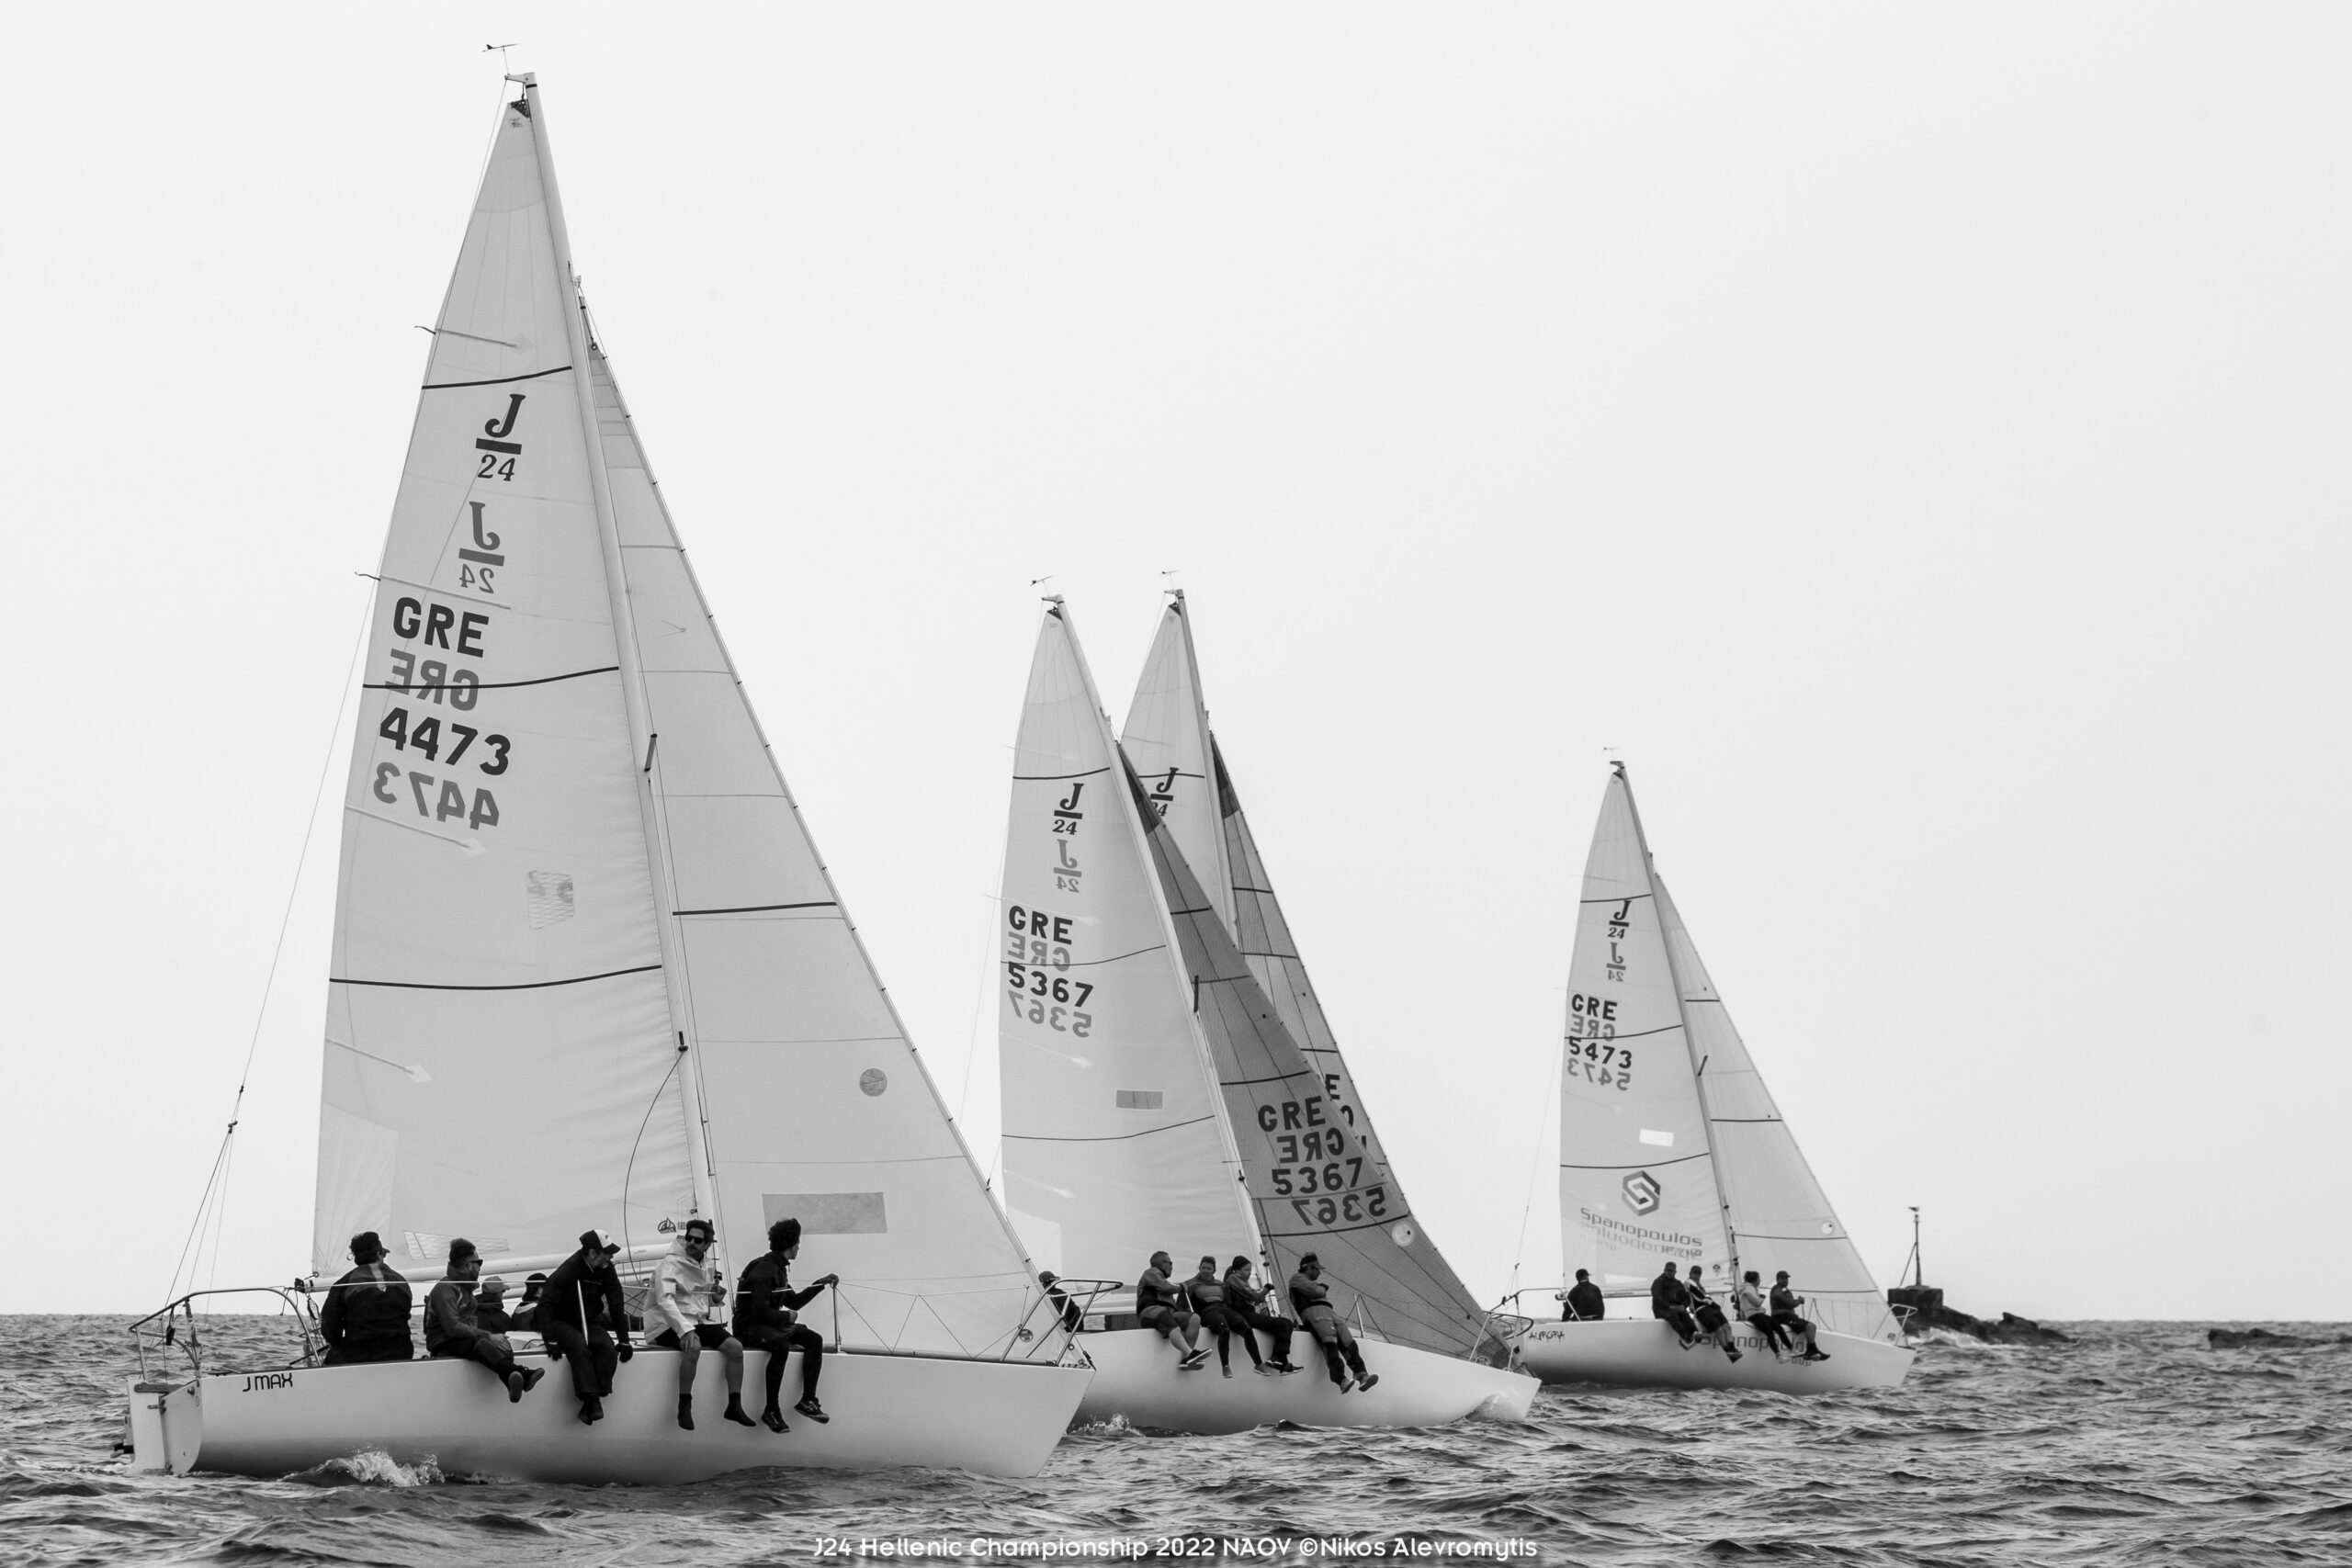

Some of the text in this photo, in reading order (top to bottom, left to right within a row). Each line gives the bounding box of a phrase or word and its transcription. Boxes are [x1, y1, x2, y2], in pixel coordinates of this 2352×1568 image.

[485, 393, 526, 438] J
[477, 455, 516, 482] 24
[392, 596, 491, 659] GRE
[379, 707, 511, 776] 4473
[1059, 783, 1084, 811] J
[1156, 767, 1180, 793] J
[1052, 819, 1078, 836] 24
[1009, 905, 1073, 945] GRE
[1613, 900, 1632, 920] J
[1608, 927, 1625, 939] 24
[1008, 962, 1094, 1008] 5367
[1571, 994, 1618, 1021] GRE
[1568, 1036, 1632, 1069] 5473
[1258, 1096, 1326, 1133] GRE
[1272, 1157, 1363, 1195] 5367
[1580, 1207, 1702, 1247] Spanopoulos
